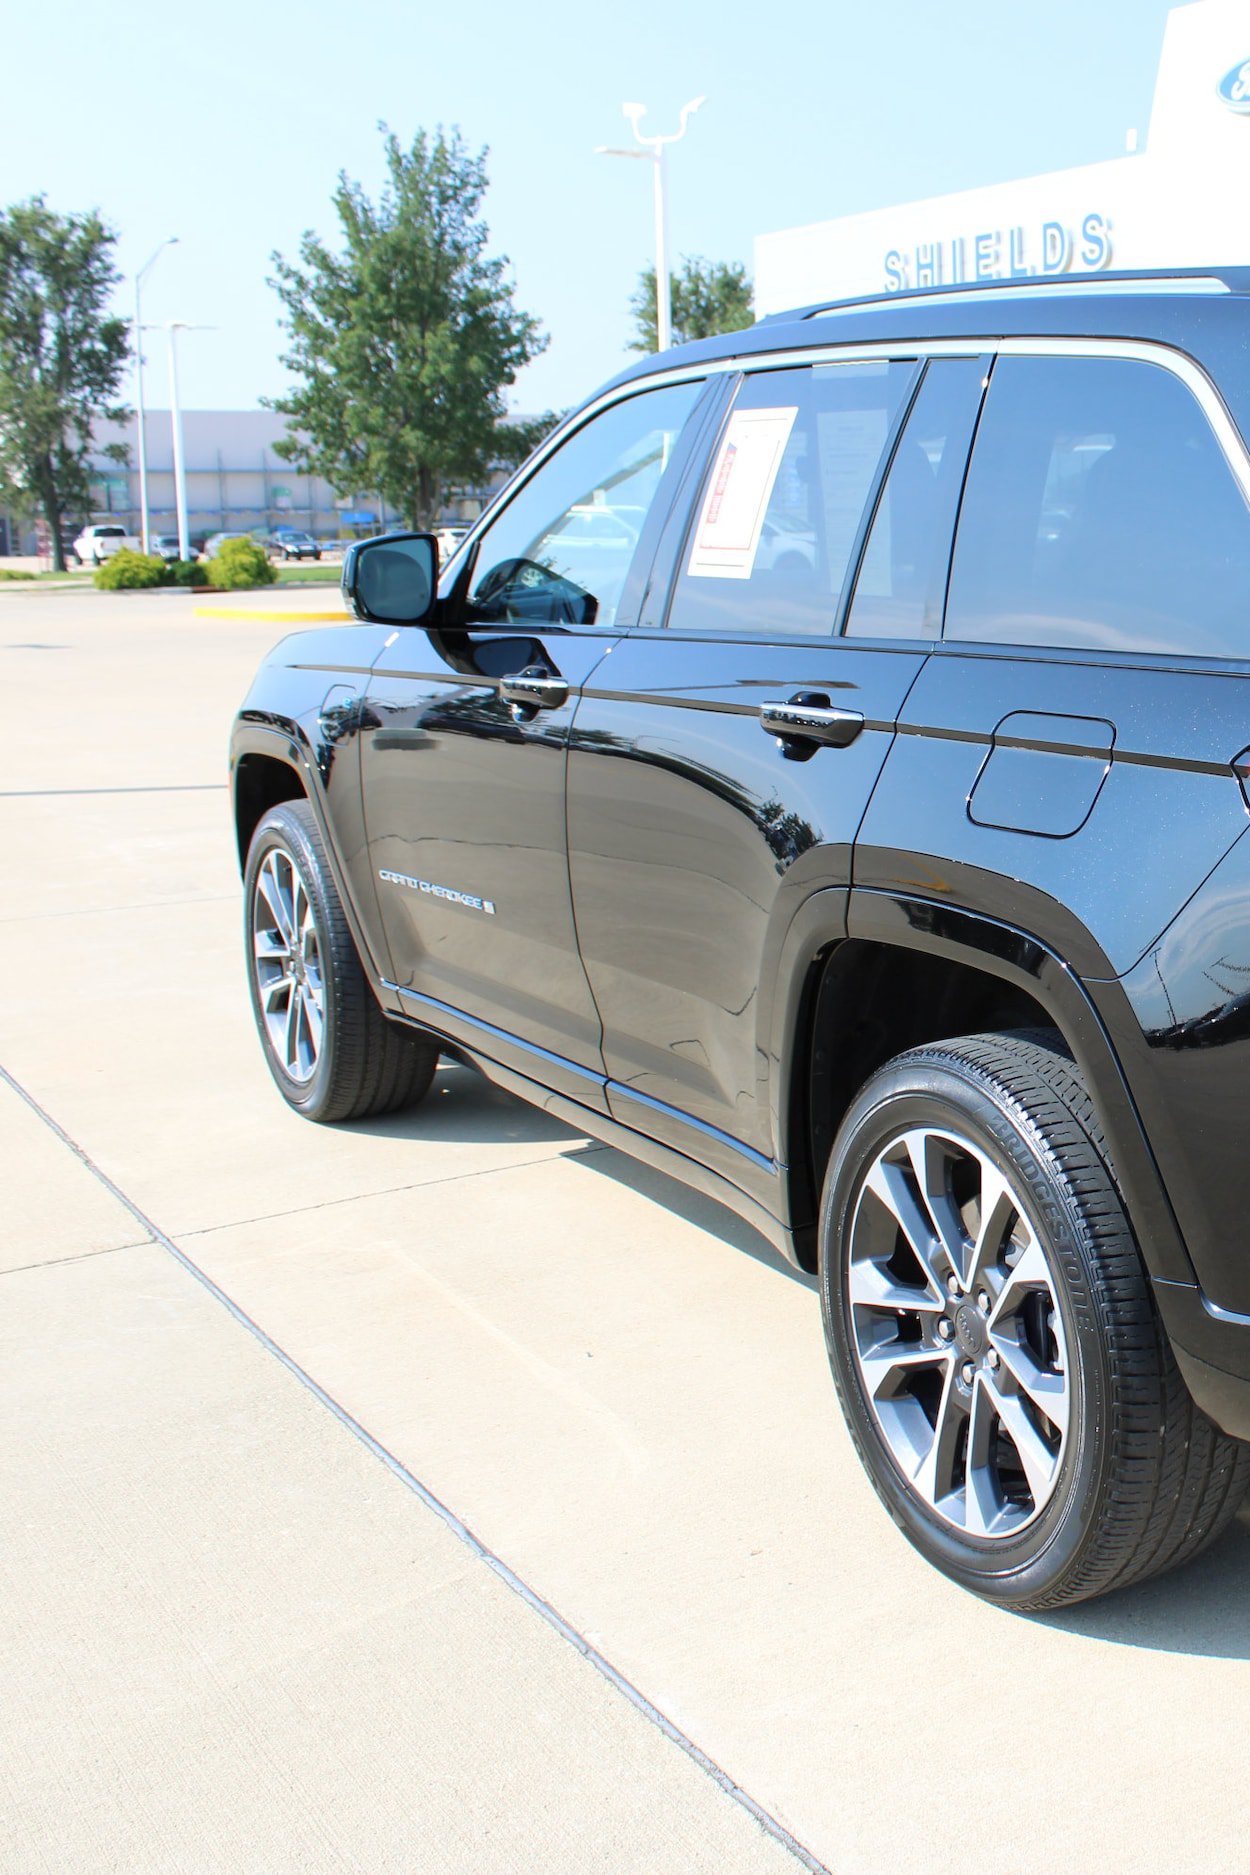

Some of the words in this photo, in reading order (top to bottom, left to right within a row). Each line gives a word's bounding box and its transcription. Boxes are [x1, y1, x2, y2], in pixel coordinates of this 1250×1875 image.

[884, 213, 1112, 294] SHIELDS
[379, 869, 418, 889] GRAND
[420, 881, 483, 910] CHEROKEE
